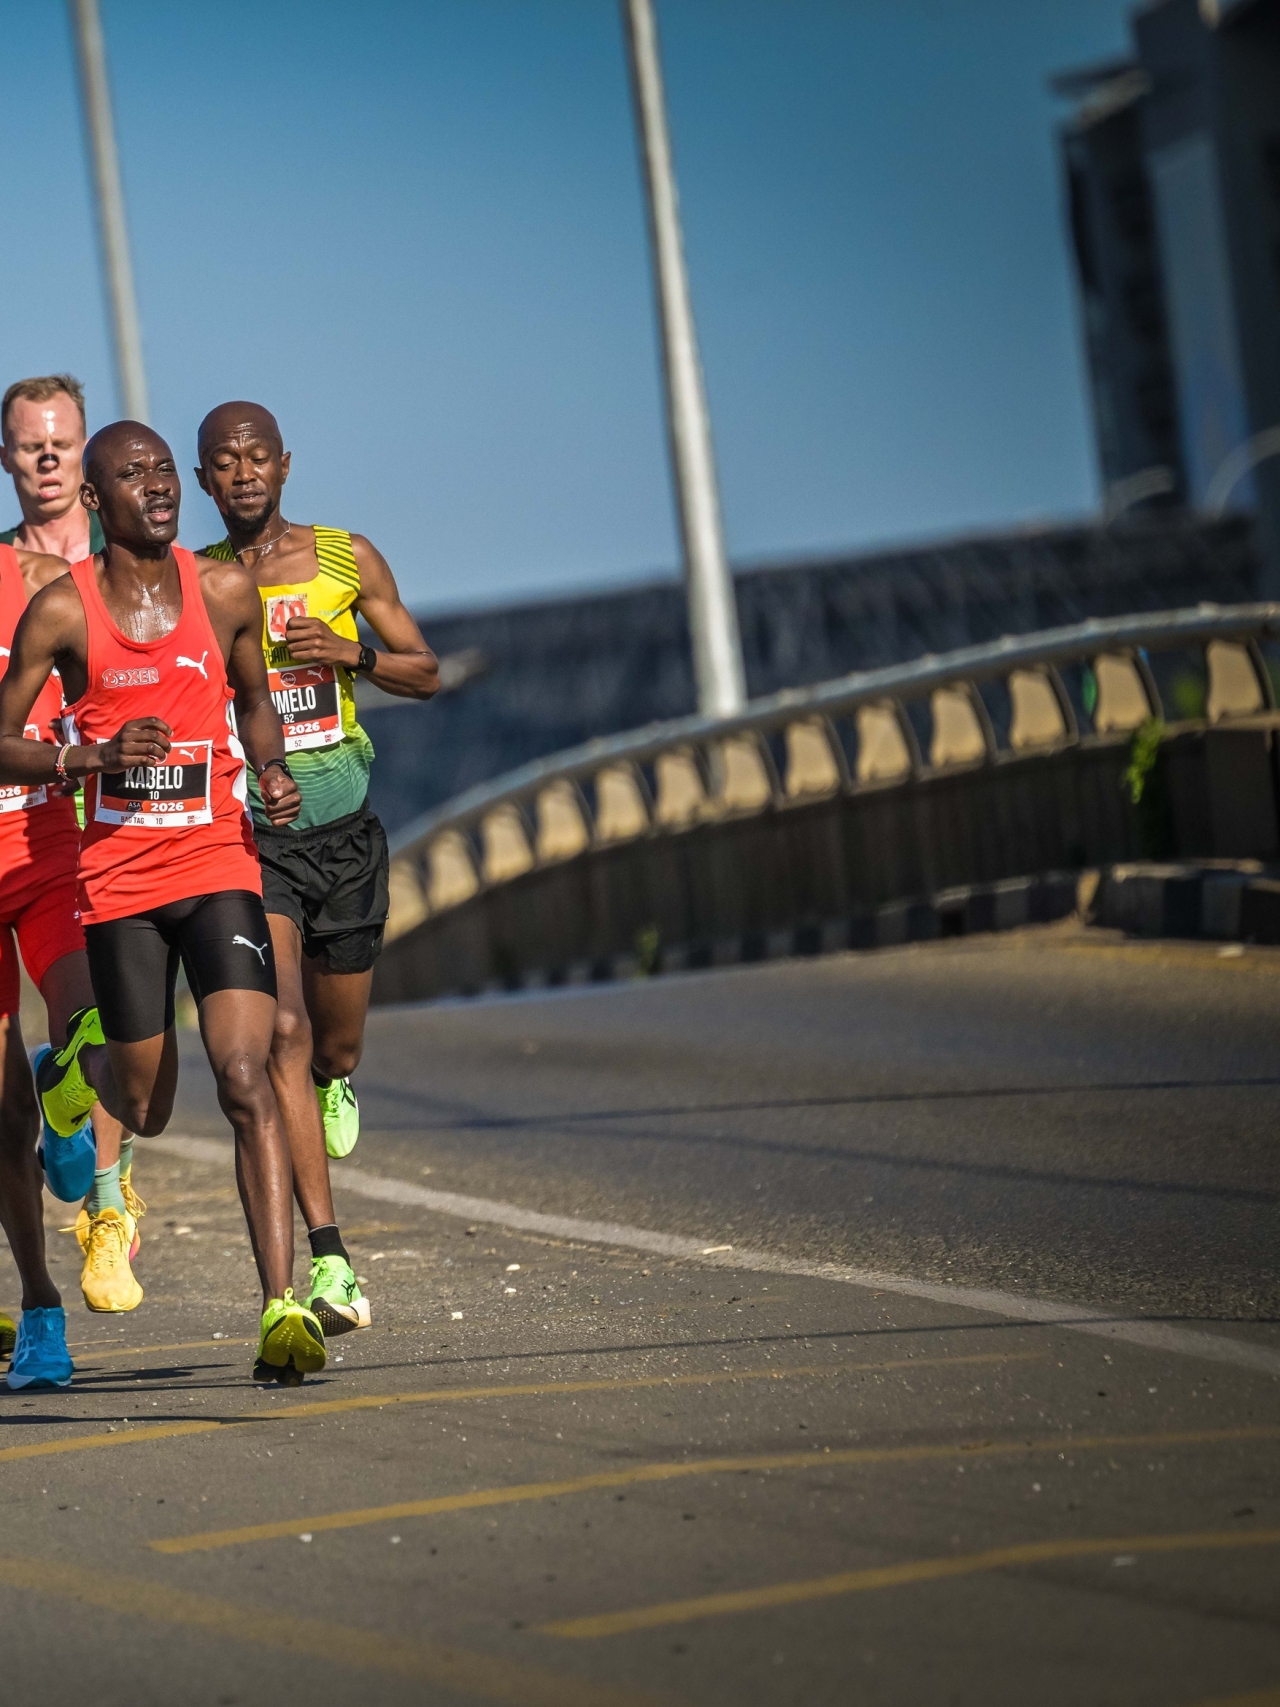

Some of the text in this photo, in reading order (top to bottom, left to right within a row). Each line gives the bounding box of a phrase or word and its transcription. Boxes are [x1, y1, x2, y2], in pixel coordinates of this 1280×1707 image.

[102, 667, 159, 688] BOXER
[283, 713, 295, 724] 52
[288, 721, 320, 736] 2026
[294, 739, 302, 748] 52
[125, 765, 184, 790] KABELO
[149, 790, 160, 800] 10
[150, 802, 184, 812] 2026
[121, 815, 163, 825] BAG TAG 10
